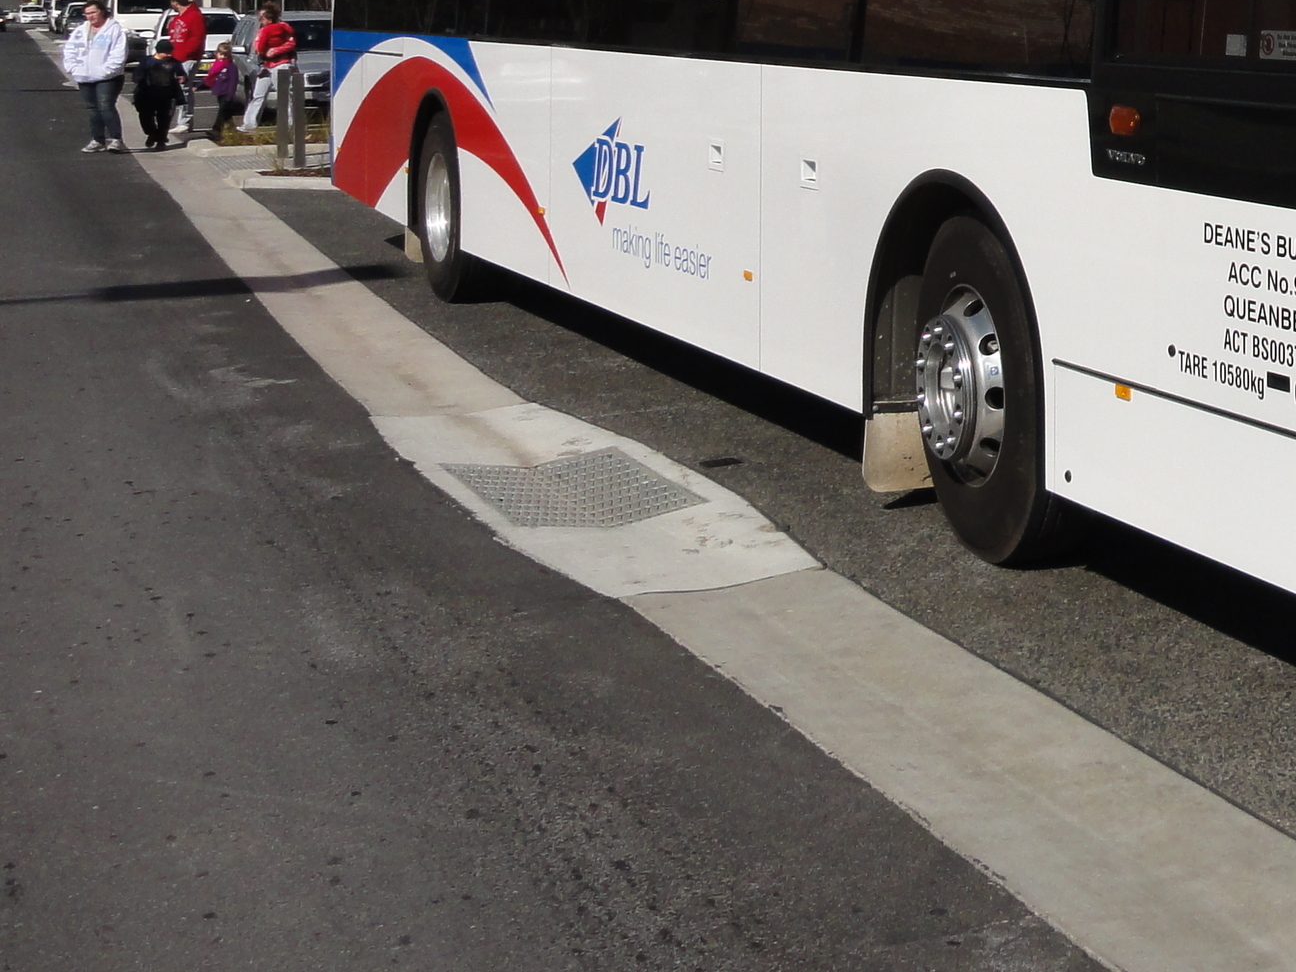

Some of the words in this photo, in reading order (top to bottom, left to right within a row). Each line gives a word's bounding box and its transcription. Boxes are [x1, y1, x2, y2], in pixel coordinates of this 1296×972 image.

[1106, 148, 1146, 165] VOLVO
[592, 138, 650, 209] DBL
[612, 225, 651, 269] making
[655, 232, 671, 267] life
[674, 244, 712, 280] easier
[1203, 222, 1271, 255] DEANE'S
[1228, 262, 1262, 288] ACC
[1224, 328, 1248, 355] ACT
[1179, 350, 1208, 379] TARE
[1212, 360, 1264, 400] 10580kg
